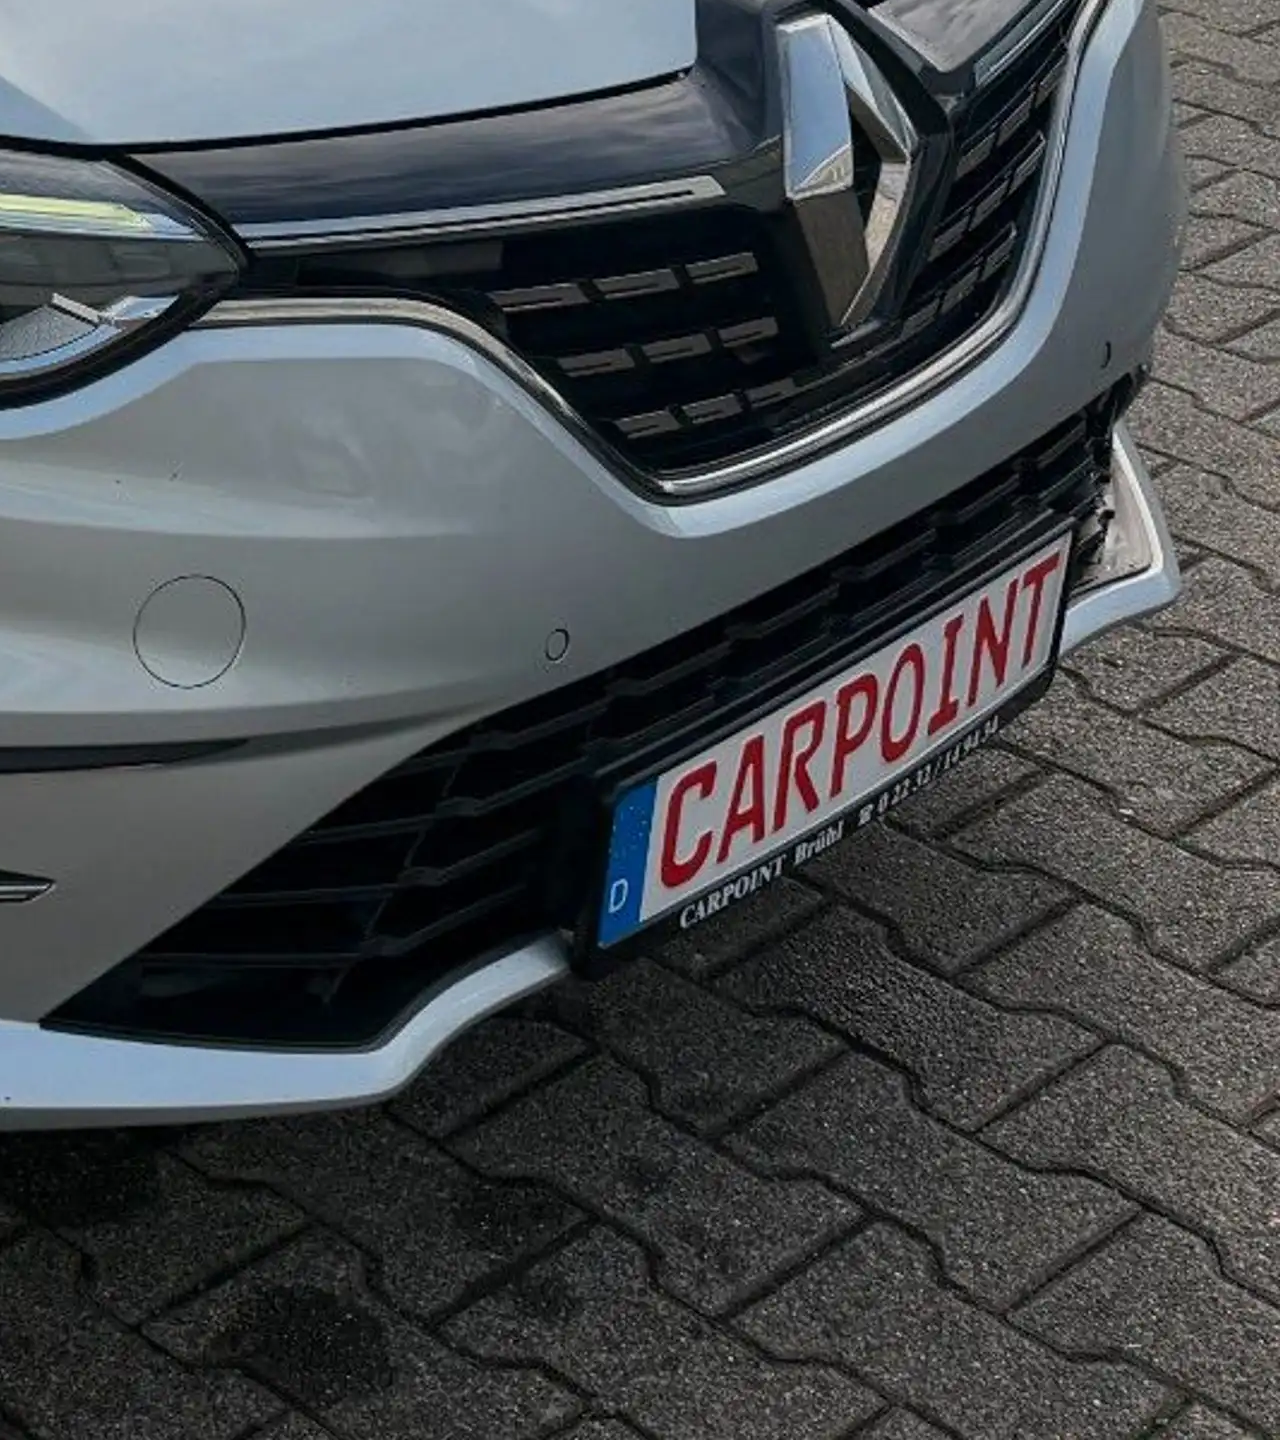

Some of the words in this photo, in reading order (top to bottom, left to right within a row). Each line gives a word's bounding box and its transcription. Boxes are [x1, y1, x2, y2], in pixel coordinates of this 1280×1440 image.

[660, 552, 1060, 889] CARPOINT
[608, 878, 628, 913] D
[679, 854, 787, 929] CARPOINT
[794, 821, 843, 864] Brühl
